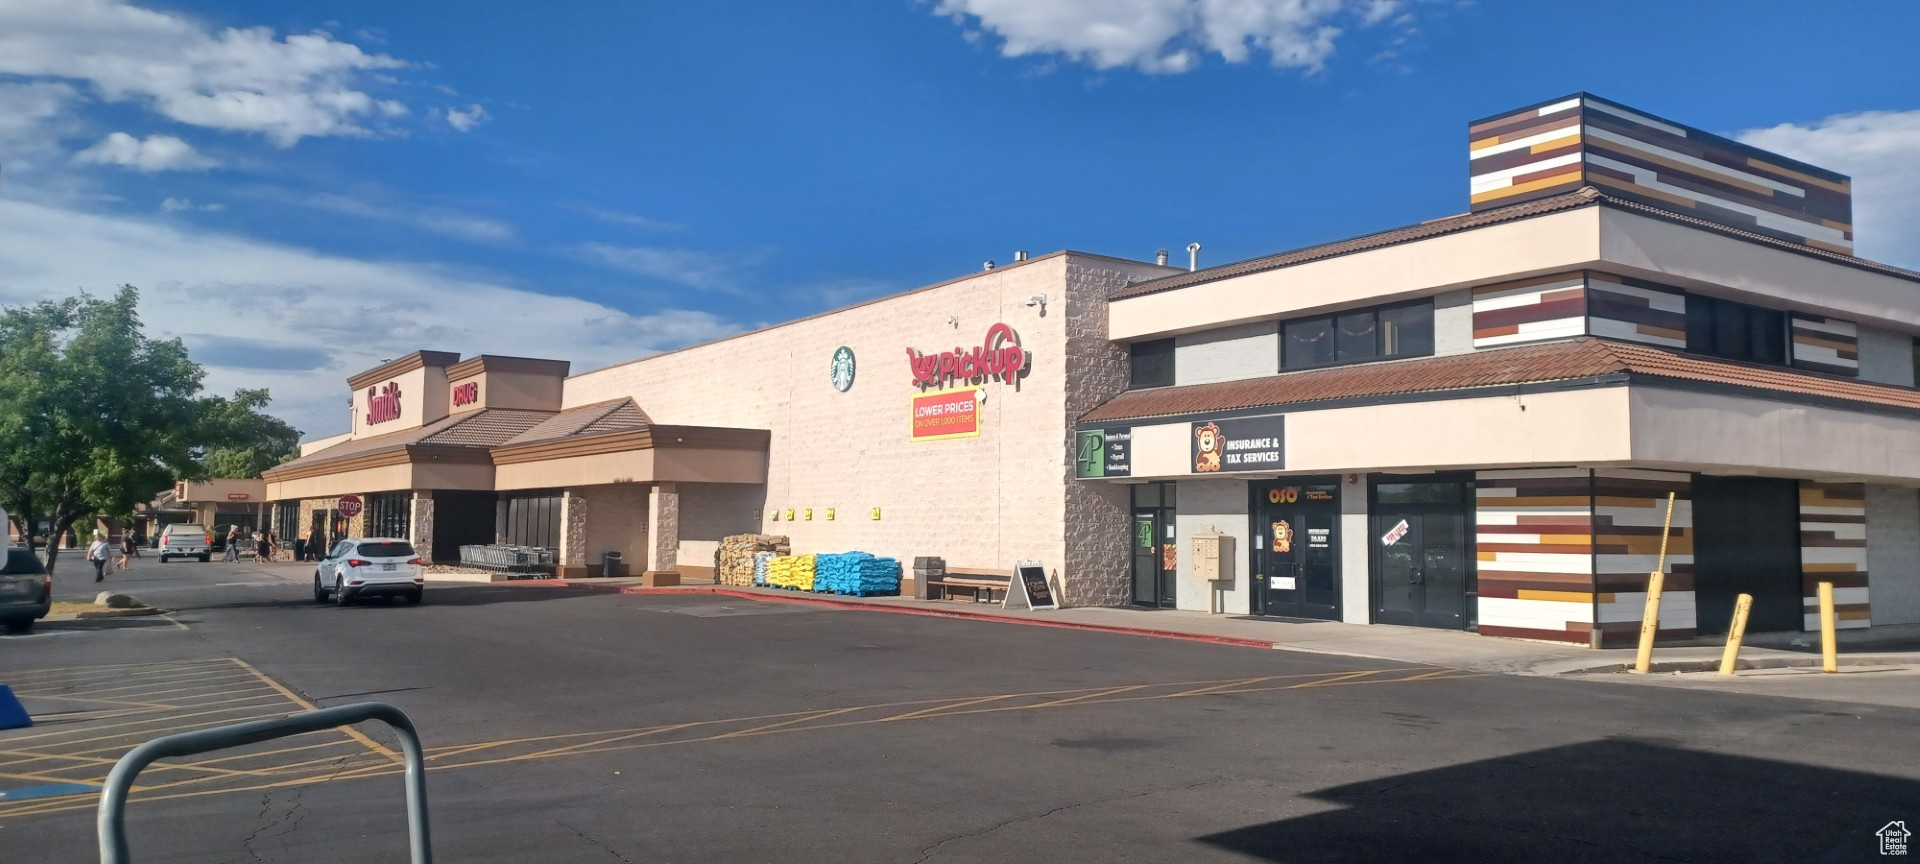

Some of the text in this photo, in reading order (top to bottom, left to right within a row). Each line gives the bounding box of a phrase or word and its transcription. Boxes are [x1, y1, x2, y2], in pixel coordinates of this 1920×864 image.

[453, 381, 478, 407] DRUG
[915, 400, 974, 418] LOWER PRICES
[915, 420, 923, 429] ON
[924, 418, 939, 428] OVER
[956, 414, 974, 424] ITEMS
[1227, 438, 1279, 450] INSURANCE &
[1226, 452, 1279, 464] TAX SERVICES
[340, 501, 361, 511] STOP
